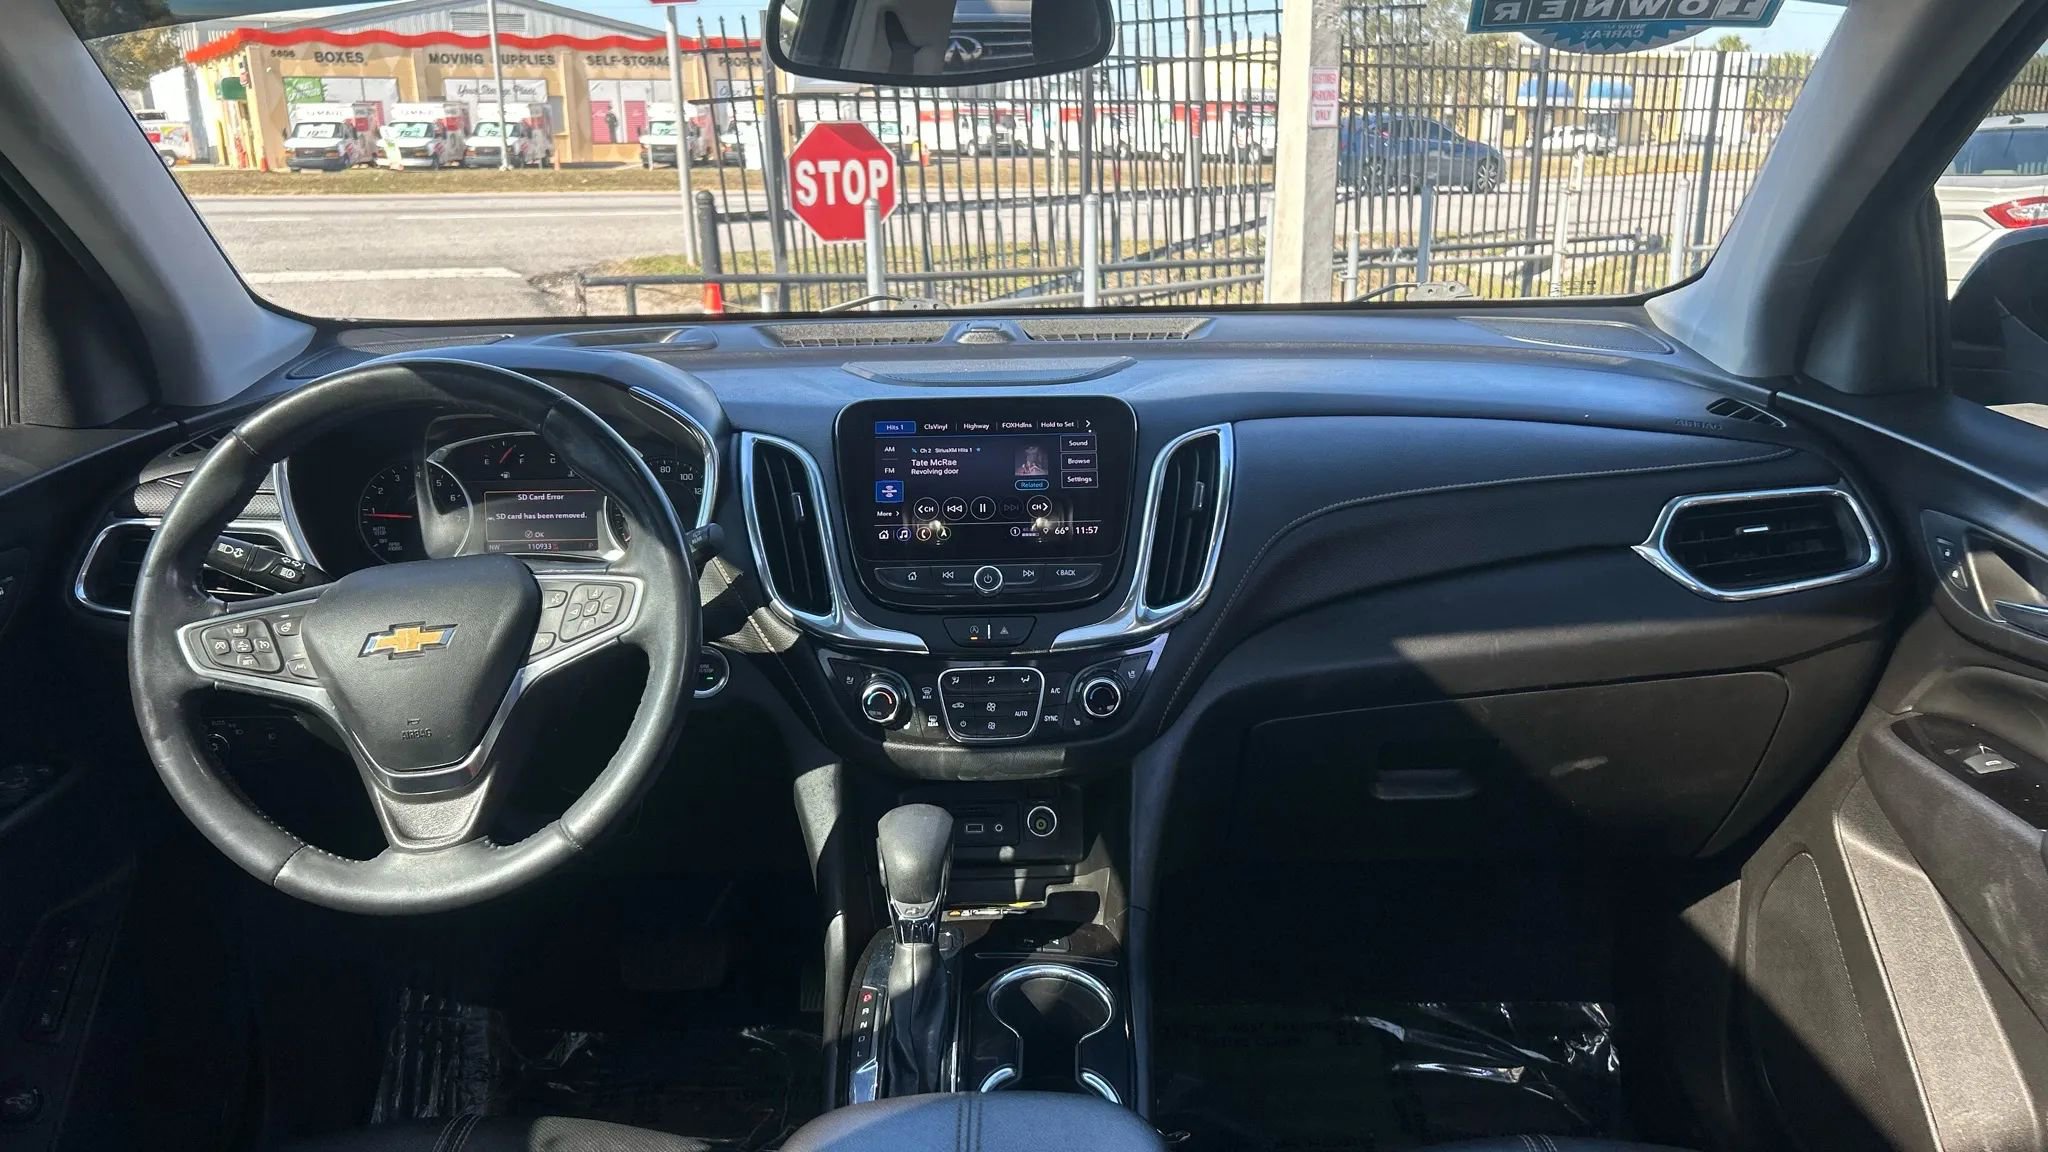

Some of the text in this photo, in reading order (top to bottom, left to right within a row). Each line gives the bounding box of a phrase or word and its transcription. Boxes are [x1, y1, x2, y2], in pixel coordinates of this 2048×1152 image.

[314, 52, 364, 63] BOXES
[428, 53, 556, 65] MOVING UPPLIES
[586, 55, 671, 66] SELF-STORAG
[795, 159, 889, 206] STOP
[963, 423, 990, 431] Highway
[911, 468, 942, 476] Revolving
[395, 474, 400, 482] 3
[680, 473, 693, 481] 100
[436, 479, 442, 487] 5
[377, 487, 384, 495] 2
[694, 487, 704, 495] 12
[1075, 526, 1099, 534] 11:57
[863, 994, 873, 1003] P
[861, 1007, 870, 1015] R
[860, 1021, 868, 1029] N
[858, 1035, 866, 1043] D
